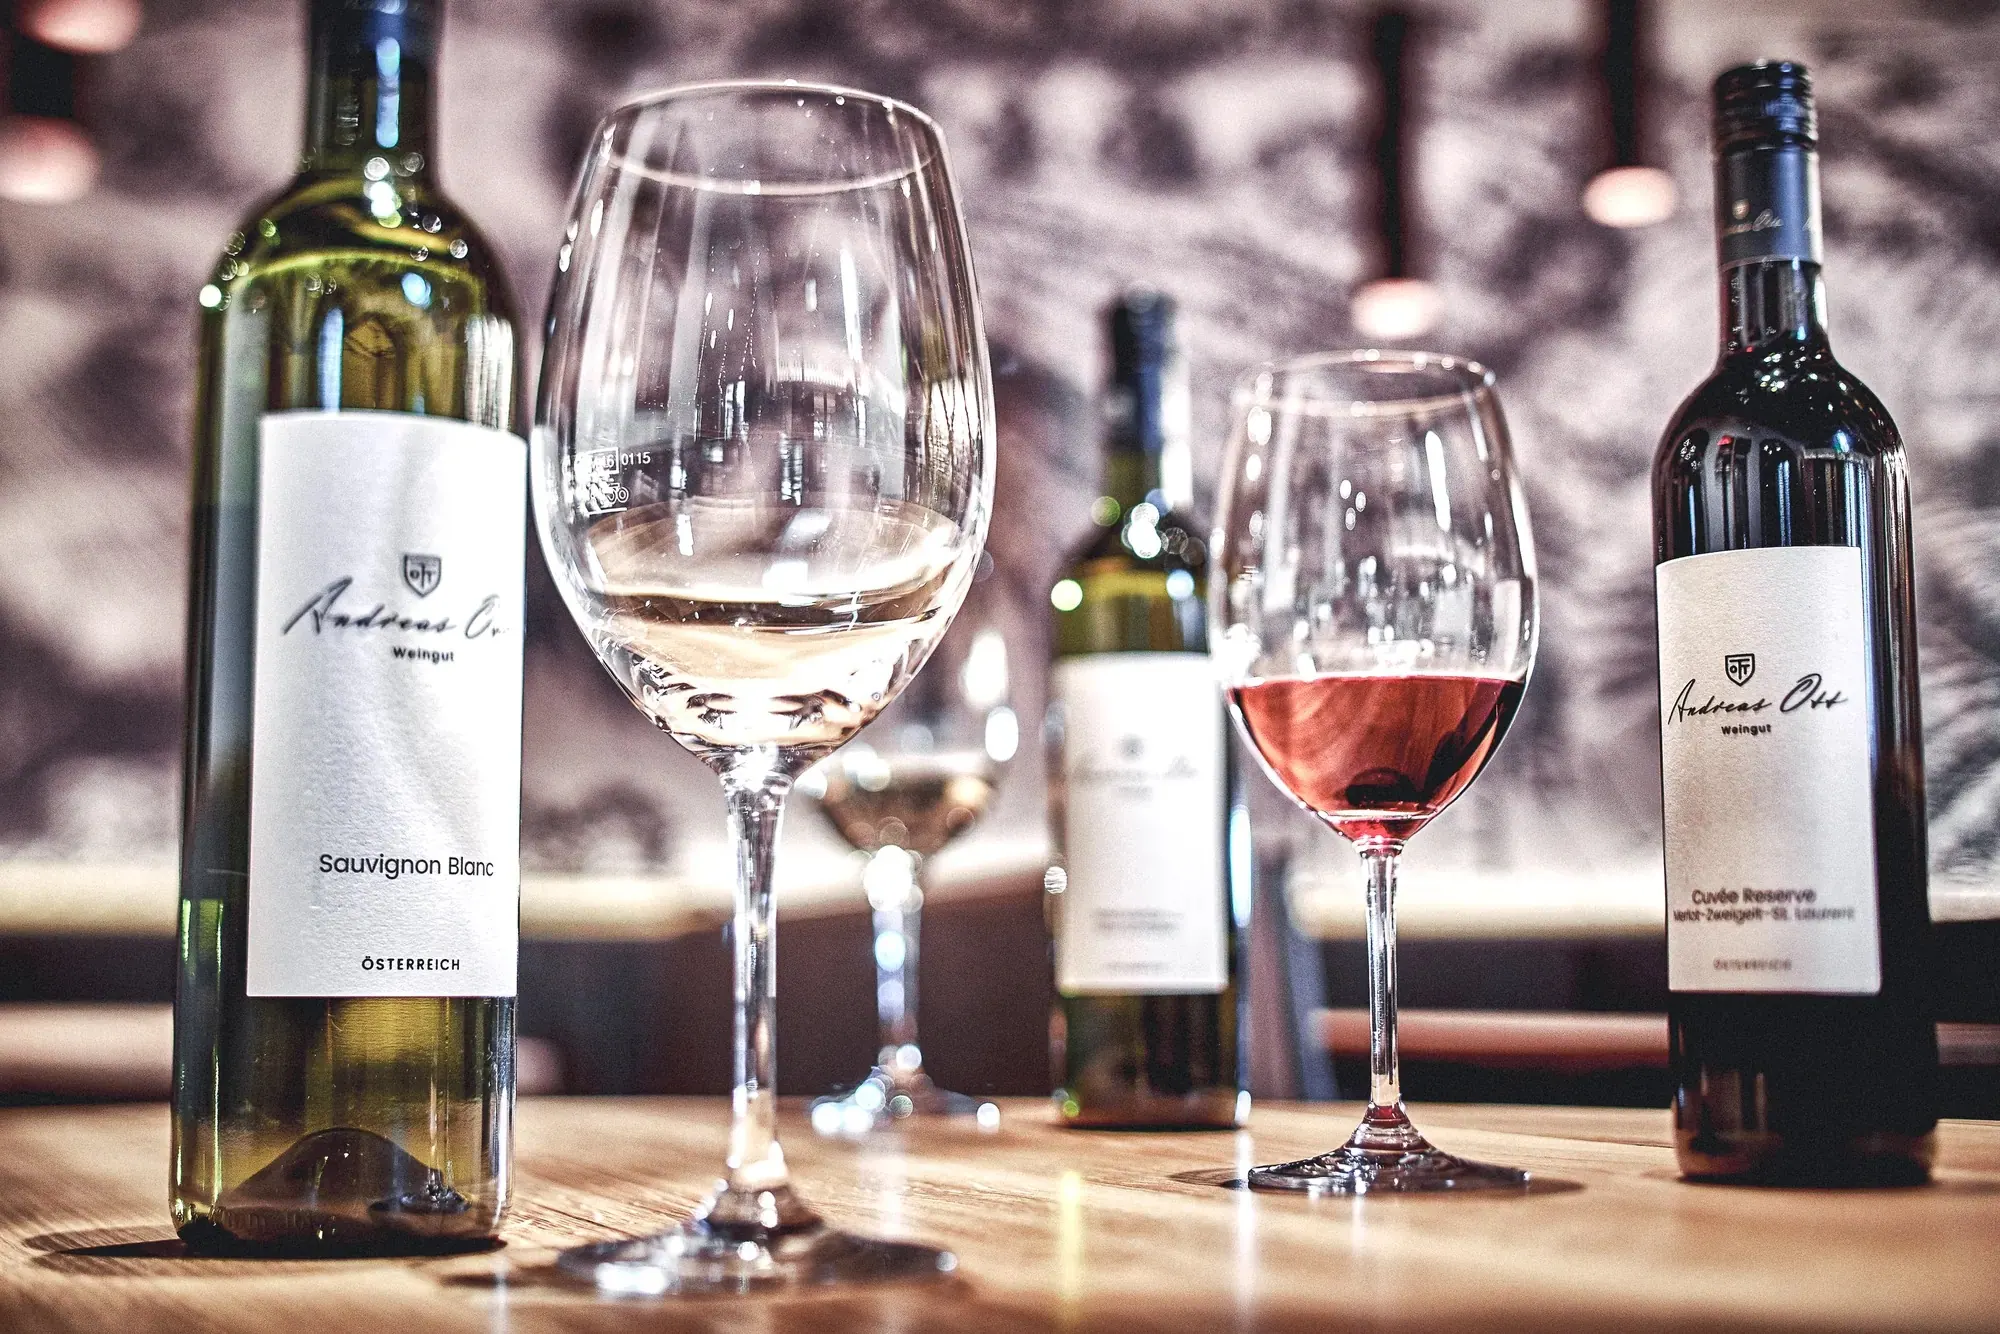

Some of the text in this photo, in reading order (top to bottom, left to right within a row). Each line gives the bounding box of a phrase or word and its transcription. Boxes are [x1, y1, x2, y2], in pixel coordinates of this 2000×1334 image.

[621, 451, 651, 466] 0115
[282, 575, 456, 636] Andreas
[393, 647, 455, 663] Weingut
[1667, 672, 1849, 725] Andreas Ott
[1721, 723, 1772, 736] Weingut
[319, 853, 494, 880] Sauvignon Blanc
[361, 956, 460, 970] ÖSTERREICH
